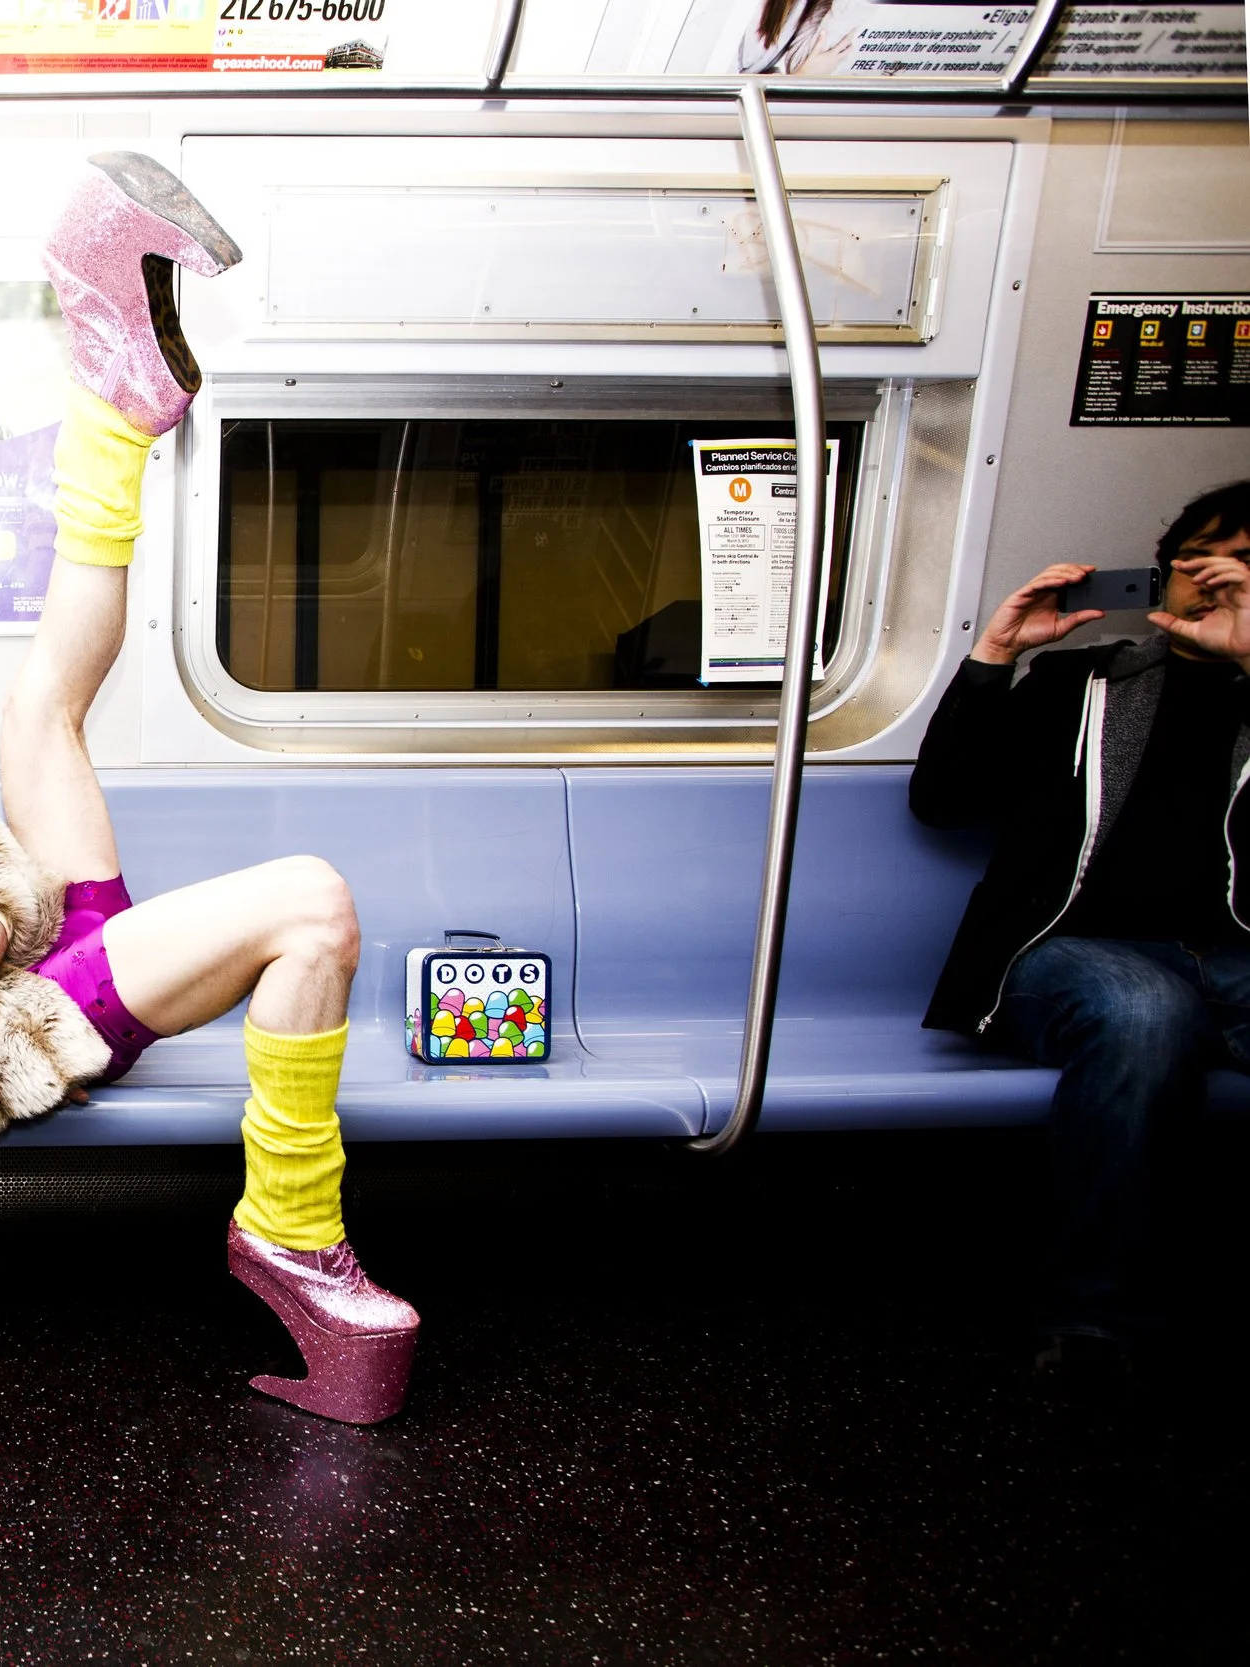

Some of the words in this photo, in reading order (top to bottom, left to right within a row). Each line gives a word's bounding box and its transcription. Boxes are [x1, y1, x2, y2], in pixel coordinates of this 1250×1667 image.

[268, 0, 385, 21] 675-6600
[989, 9, 1035, 25] Eligibl
[858, 29, 868, 39] A
[868, 30, 941, 41] comprehensive
[941, 30, 997, 42] psychiatric
[859, 43, 909, 52] evaluation
[910, 43, 927, 52] for
[927, 43, 981, 54] depression
[212, 56, 323, 71] apexschool.com
[851, 60, 877, 70] FREE
[878, 60, 923, 70] Treatment
[923, 61, 932, 70] in
[941, 61, 980, 71] research
[980, 61, 1007, 72] study
[1097, 301, 1178, 318] Emergency
[1181, 301, 1250, 315] Instructio
[711, 452, 749, 462] Planned
[750, 451, 782, 461] Service
[783, 451, 797, 461] Cha
[706, 464, 739, 472] Cambios
[740, 463, 781, 472] planificados
[734, 482, 747, 497] M
[774, 487, 795, 496] Central
[438, 964, 538, 984] DOTS
